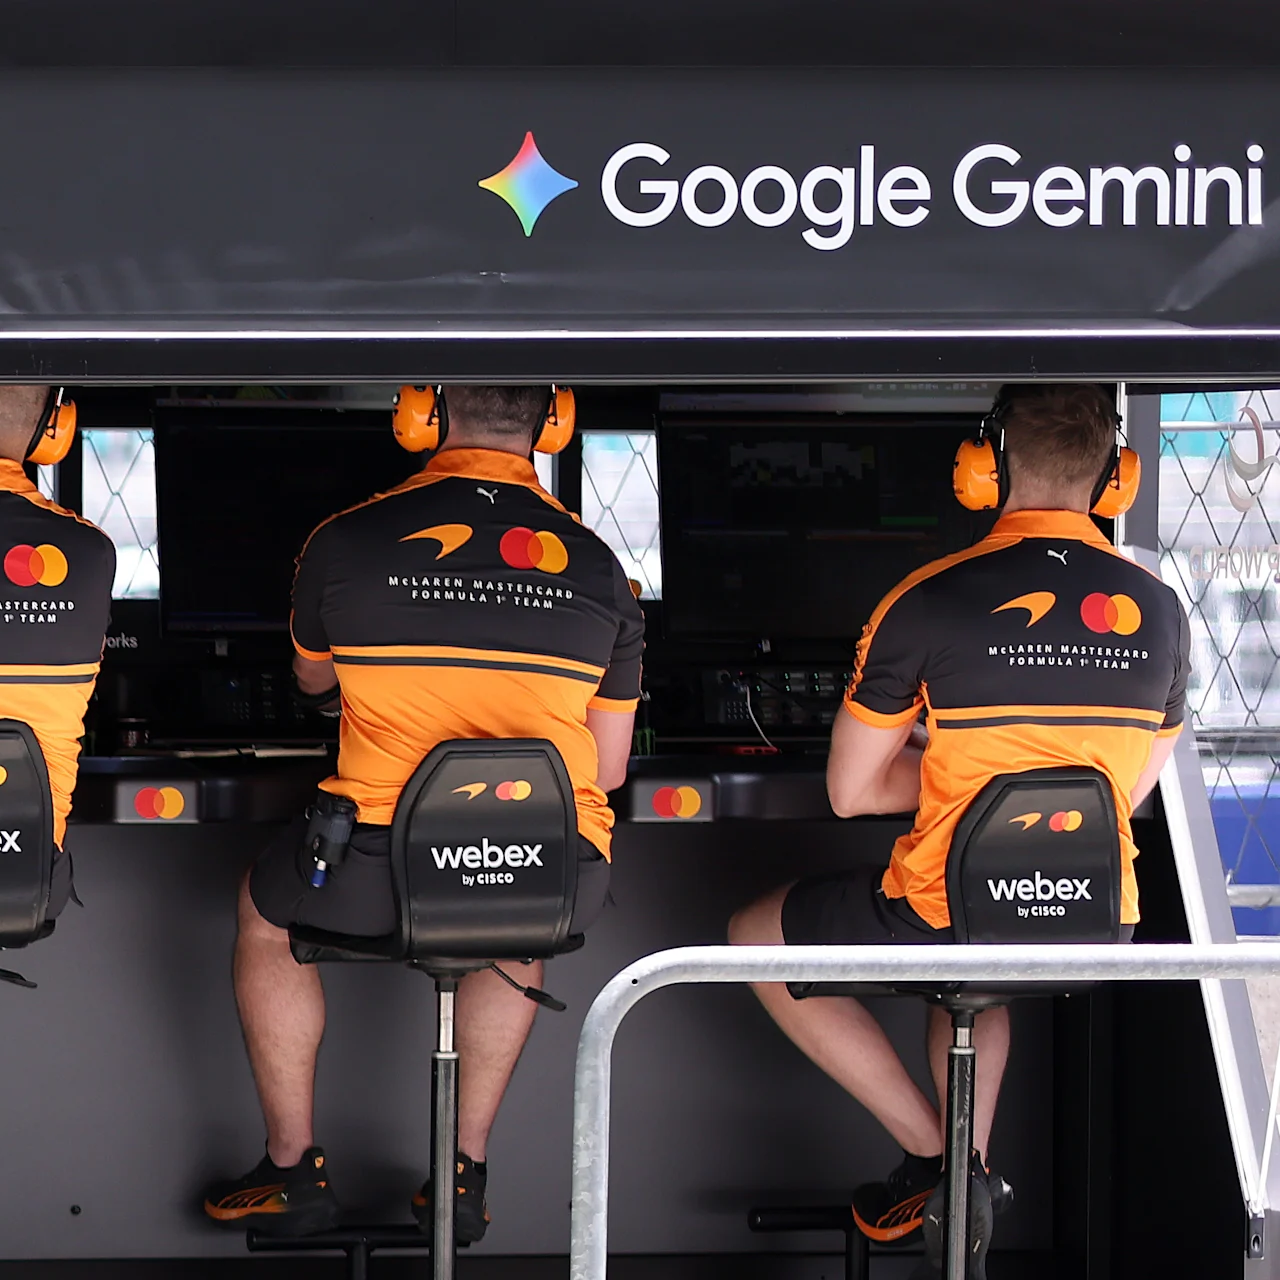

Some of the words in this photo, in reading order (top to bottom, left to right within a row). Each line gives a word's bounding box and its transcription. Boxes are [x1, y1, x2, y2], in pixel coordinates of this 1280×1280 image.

[600, 142, 931, 251] Google
[952, 143, 1264, 227] Gemini
[472, 579, 573, 600] MASTERCARD
[411, 589, 487, 603] FORMULA
[513, 596, 553, 610] TEAM
[19, 613, 57, 624] TEAM
[1060, 644, 1149, 660] MASTERCARD
[1009, 656, 1073, 667] FORMULA
[1094, 658, 1130, 670] TEAM
[430, 837, 544, 870] webex
[461, 873, 475, 887] by
[476, 872, 515, 885] CISCO
[987, 870, 1092, 901] webex
[1017, 905, 1030, 919] by
[1030, 905, 1066, 917] CISCO
